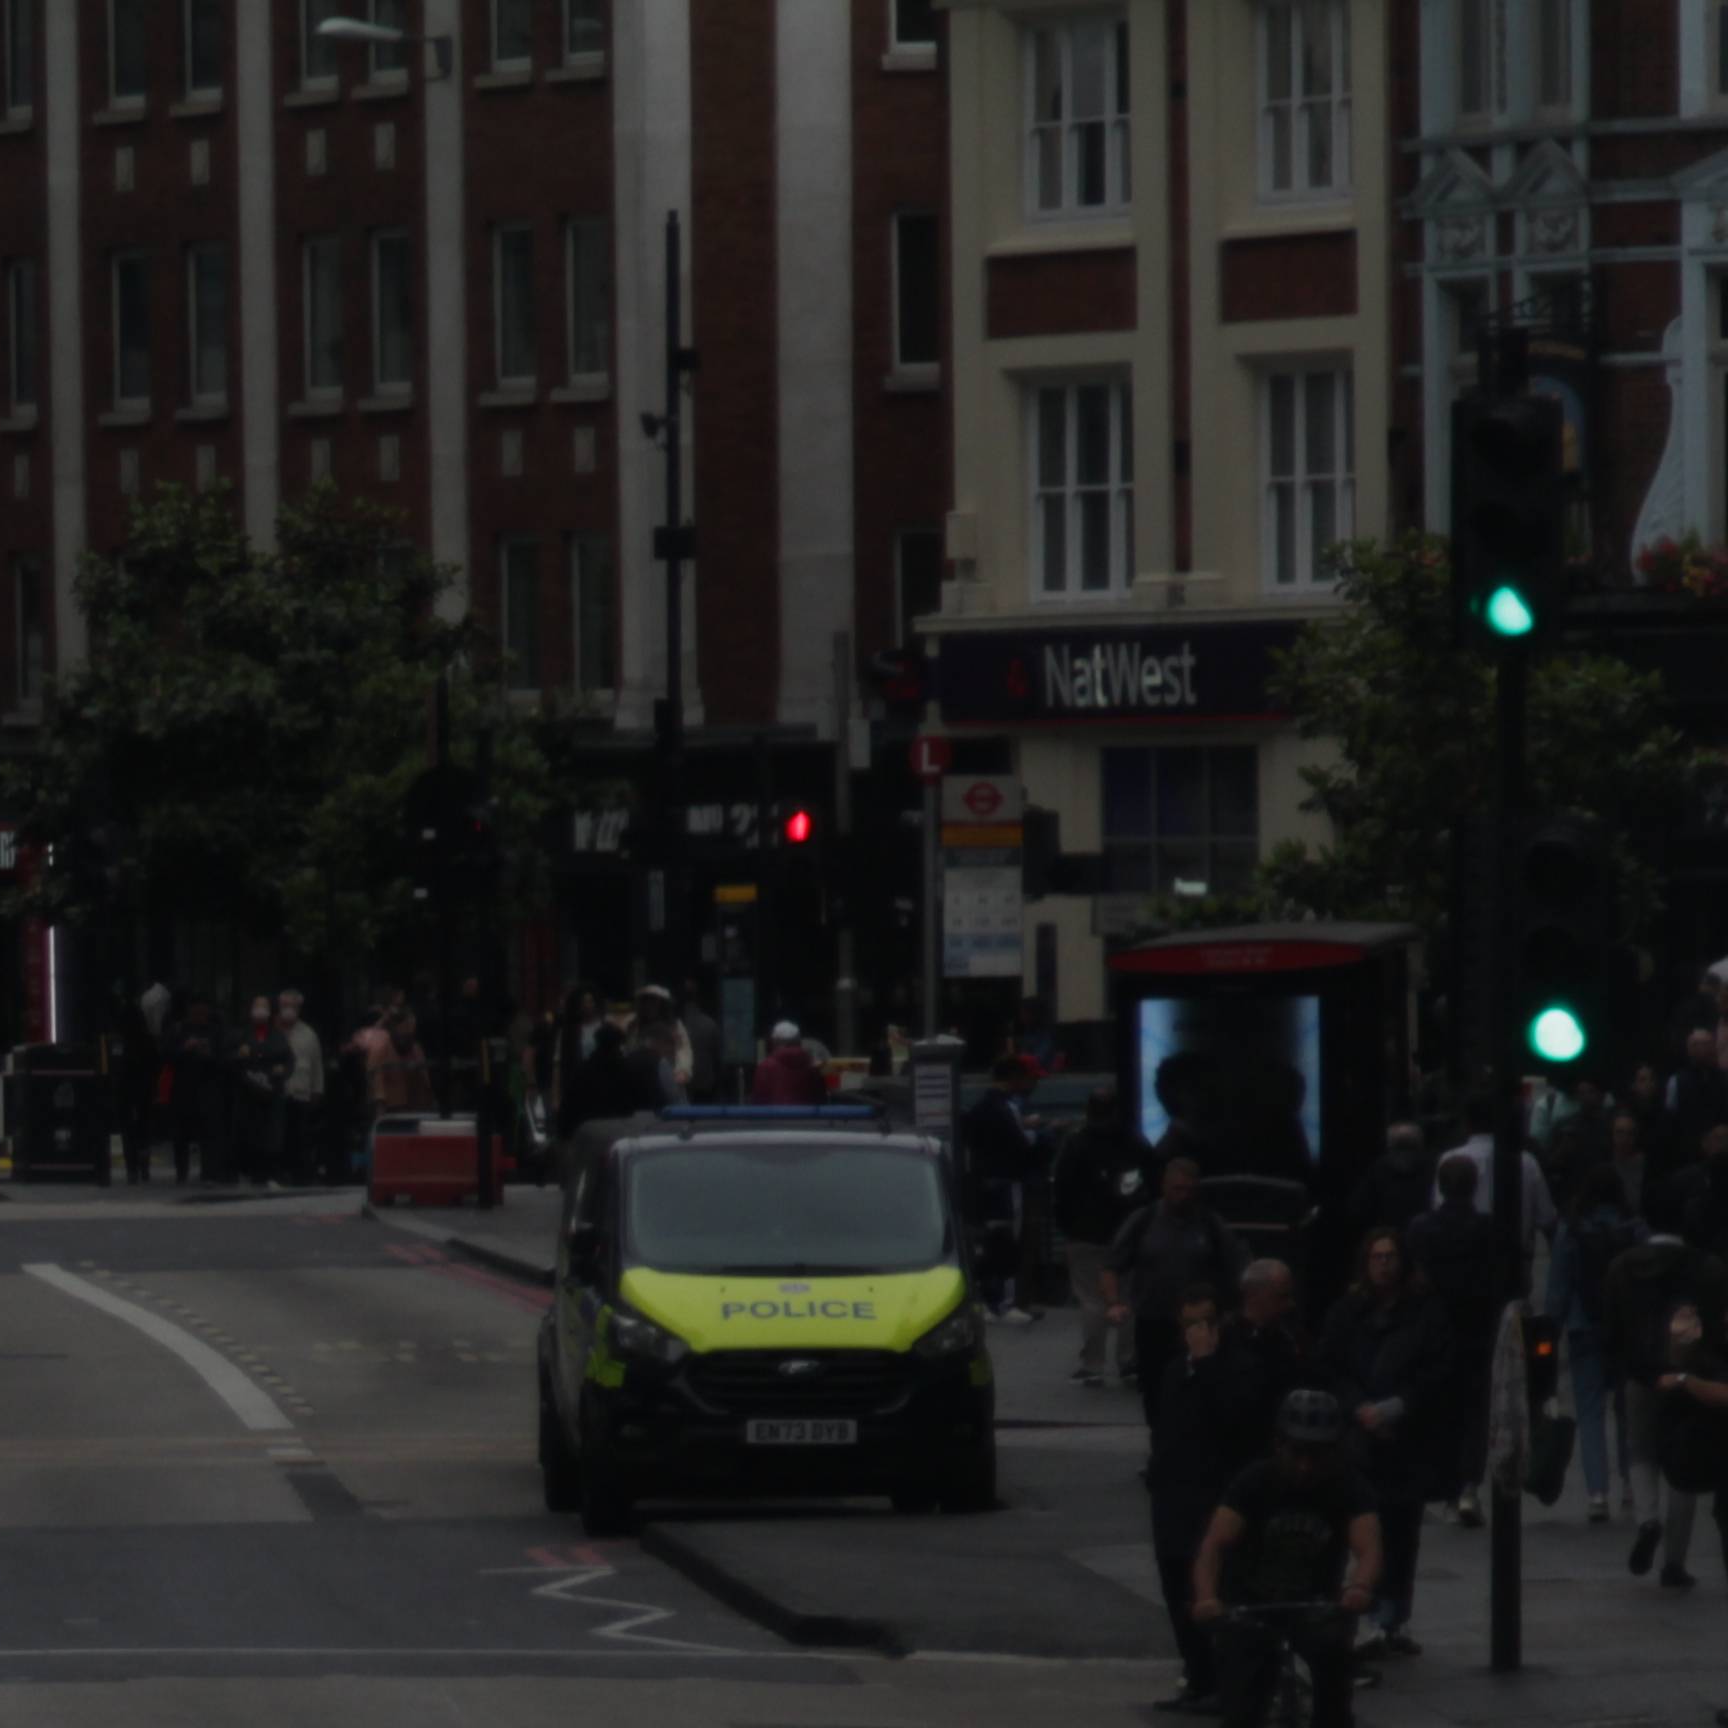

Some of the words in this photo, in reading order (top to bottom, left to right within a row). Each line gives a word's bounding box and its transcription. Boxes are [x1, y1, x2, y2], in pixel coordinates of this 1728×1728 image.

[1044, 640, 1198, 709] NatWest
[920, 741, 940, 774] L
[721, 1300, 878, 1320] POLICE
